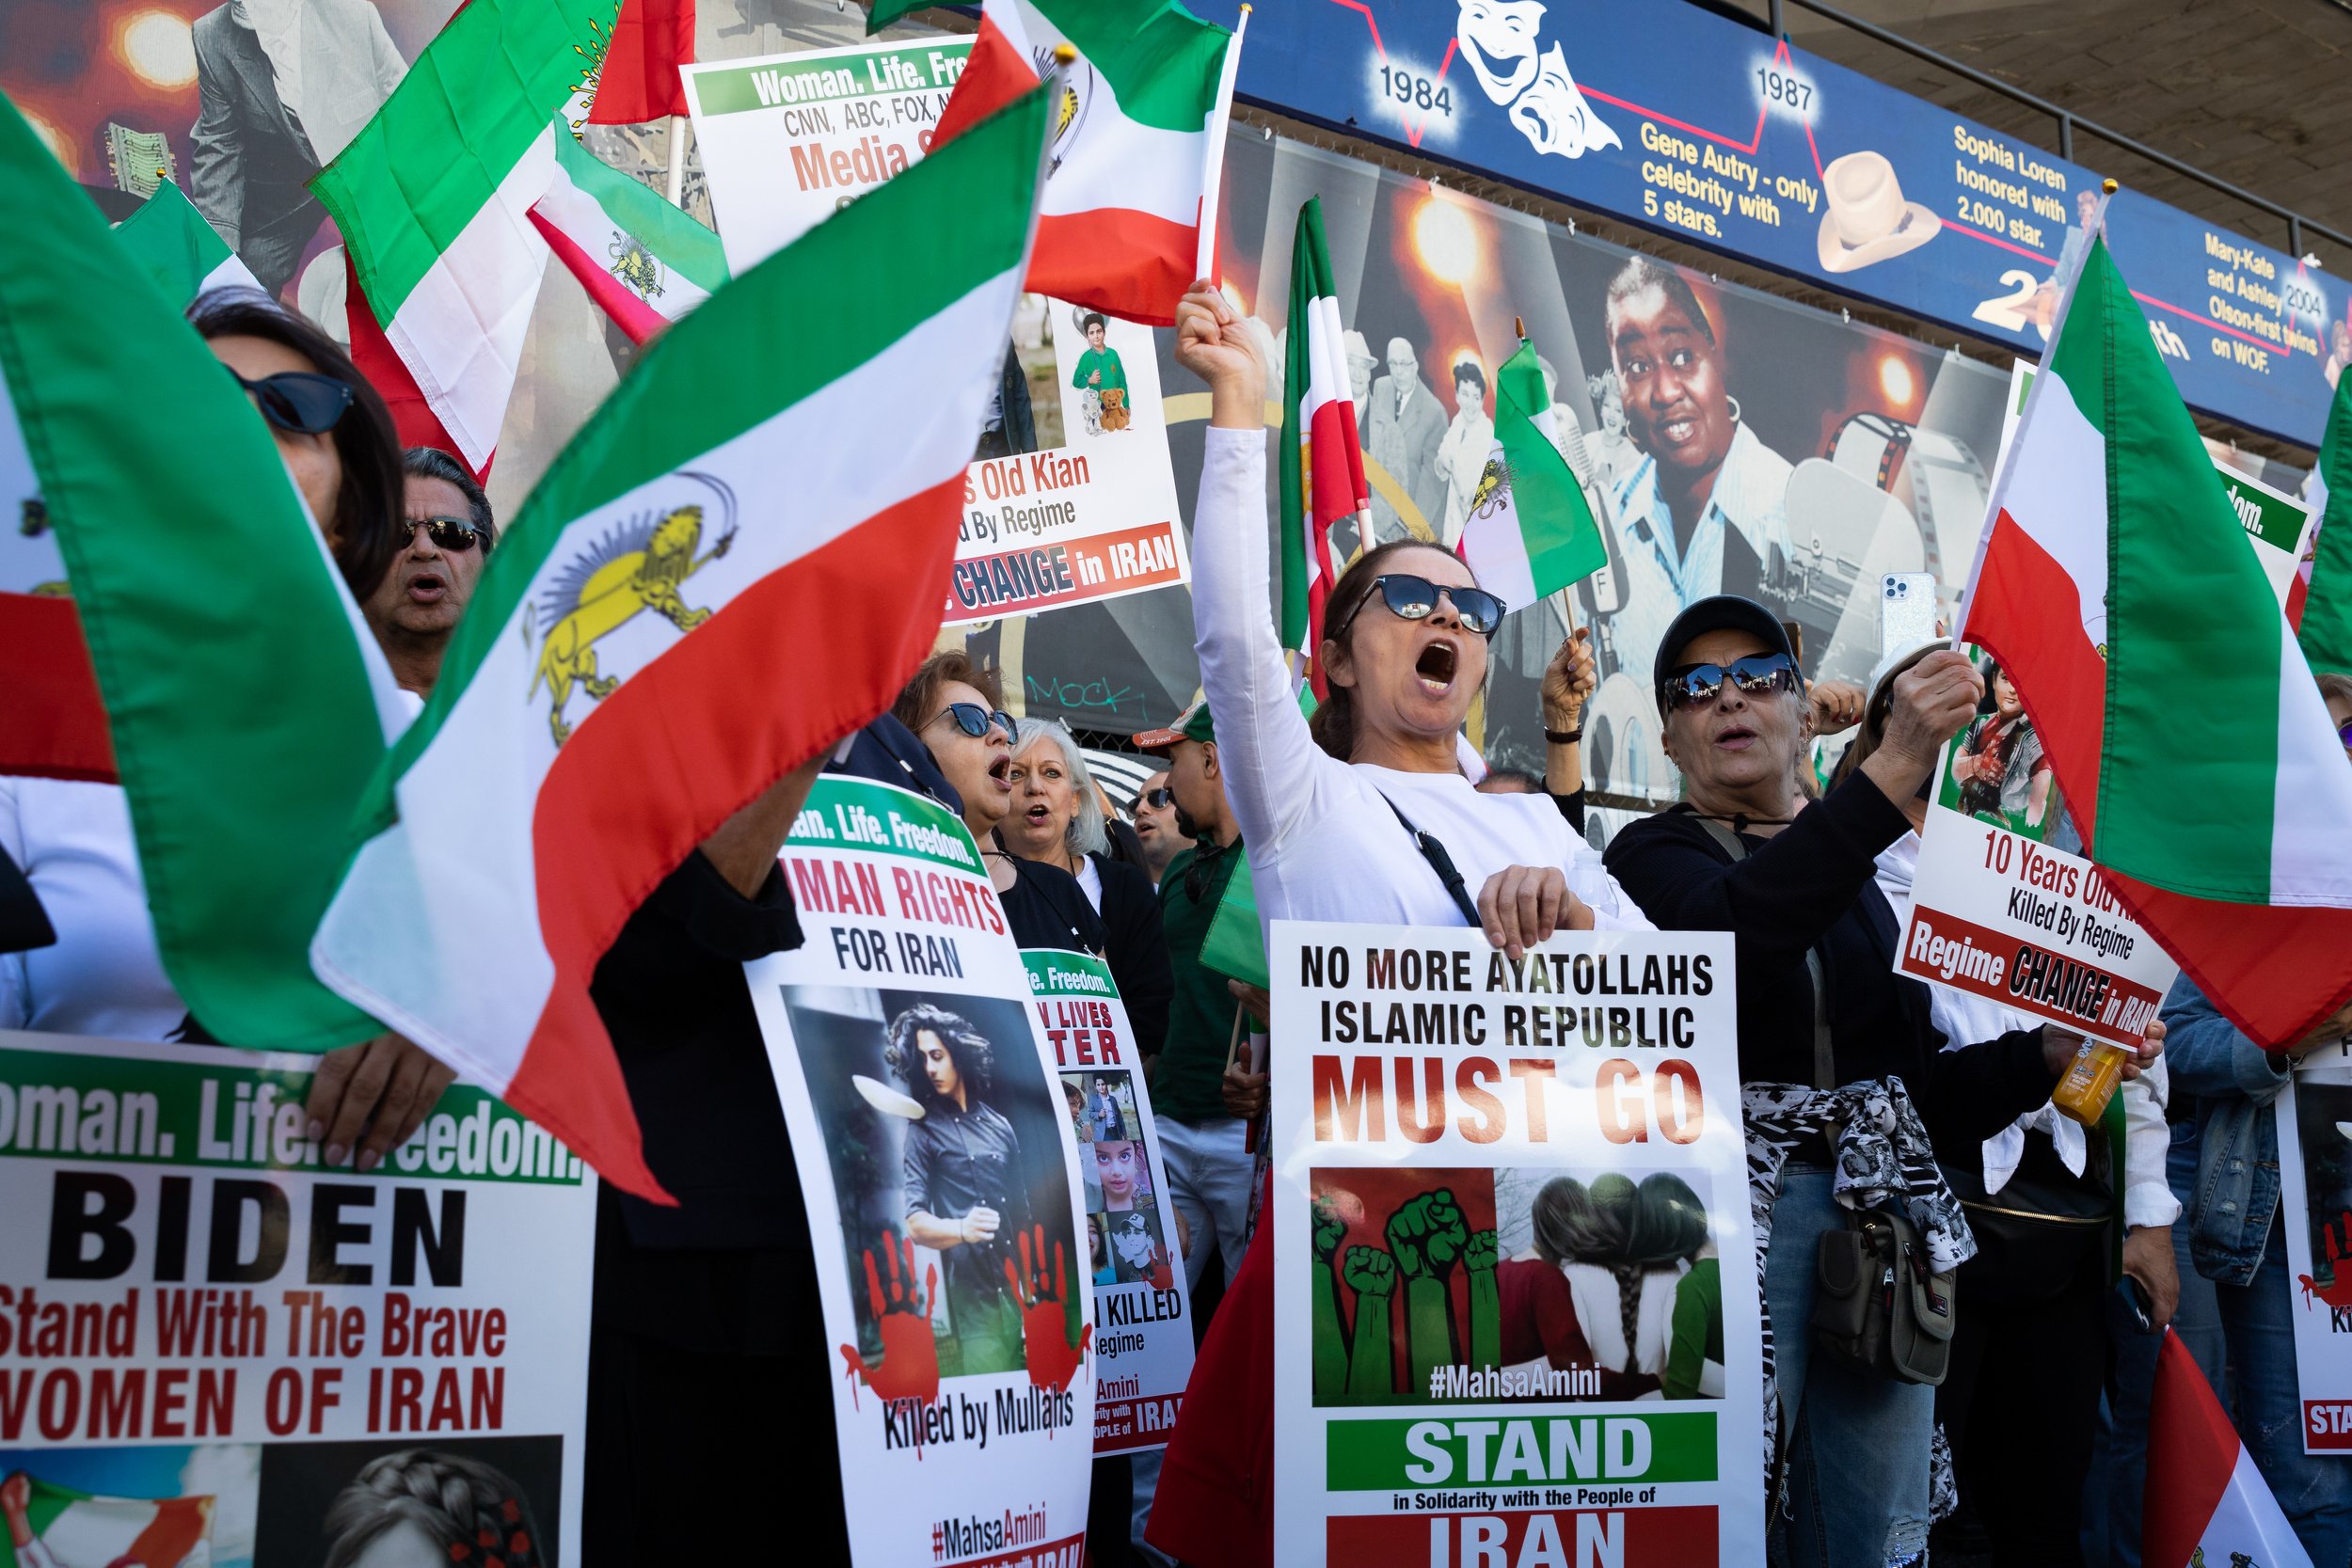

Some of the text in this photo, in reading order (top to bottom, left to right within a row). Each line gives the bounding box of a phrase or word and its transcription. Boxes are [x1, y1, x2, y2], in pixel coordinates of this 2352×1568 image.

[752, 63, 866, 106] Woman.
[866, 56, 926, 92] Life.
[1380, 65, 1453, 118] 1984
[1756, 68, 1813, 113] 1987
[784, 107, 836, 137] CNN,
[844, 100, 890, 129] ABC,
[891, 95, 936, 123] FOX,
[789, 135, 911, 192] Media
[1641, 122, 1698, 164] Gene
[1703, 144, 1758, 185] Autry
[1776, 177, 1819, 214] only
[1954, 125, 2066, 192] Sophia Loren
[1642, 161, 1781, 228] celebrity with
[1644, 189, 1723, 239] 5 stars.
[1957, 159, 2066, 224] honored with
[1958, 196, 2044, 248] 2.000 star.
[2205, 231, 2275, 280] Mary-Kate
[2207, 268, 2282, 317] and Ashley
[2286, 284, 2321, 316] 2004
[2209, 295, 2318, 356] Olson-first twins
[2212, 337, 2270, 374] on WOF.
[981, 458, 1026, 501] Old
[1030, 451, 1091, 493] Kian
[971, 511, 998, 544] By
[1001, 499, 1076, 536] Regime
[952, 534, 1177, 610] CHANGE in IRAN
[834, 803, 890, 846] Life.
[887, 811, 976, 867] Freedom.
[1984, 829, 2013, 875] 10
[2019, 839, 2079, 898] Years
[891, 865, 1005, 936] RIGHTS
[2007, 886, 2058, 931] Killed
[2057, 906, 2081, 945] By
[2081, 914, 2134, 961] Regime
[830, 927, 964, 979] FOR IRAN
[1300, 945, 1714, 997] NO MORE AYATOLLAHS
[1909, 920, 2155, 1037] Regime CHANGE in IRAN
[1047, 967, 1110, 993] Freedom.
[1057, 1001, 1113, 1029] LIVES
[1321, 1000, 1695, 1049] ISLAMIC REPUBLIC
[197, 1079, 319, 1165] Life.
[1311, 1054, 1705, 1145] MUST GO
[46, 1169, 468, 1288] BIDEN
[0, 1284, 508, 1359] Stand With The Brave
[1106, 1288, 1182, 1327] KILLED
[264, 1367, 344, 1438] OF
[366, 1367, 506, 1436] IRAN
[1429, 1361, 1601, 1400] #MahsaAmini
[882, 1383, 1073, 1450] Killed by Mullahs
[1112, 1403, 1131, 1418] with
[1122, 1421, 1132, 1435] of
[1136, 1398, 1183, 1433] IRA
[1405, 1418, 1653, 1484] STAND
[1393, 1486, 1656, 1512] in Solidarity with the People of
[932, 1500, 1045, 1561] #MahsaAmini
[1430, 1512, 1626, 1568] IRAN
